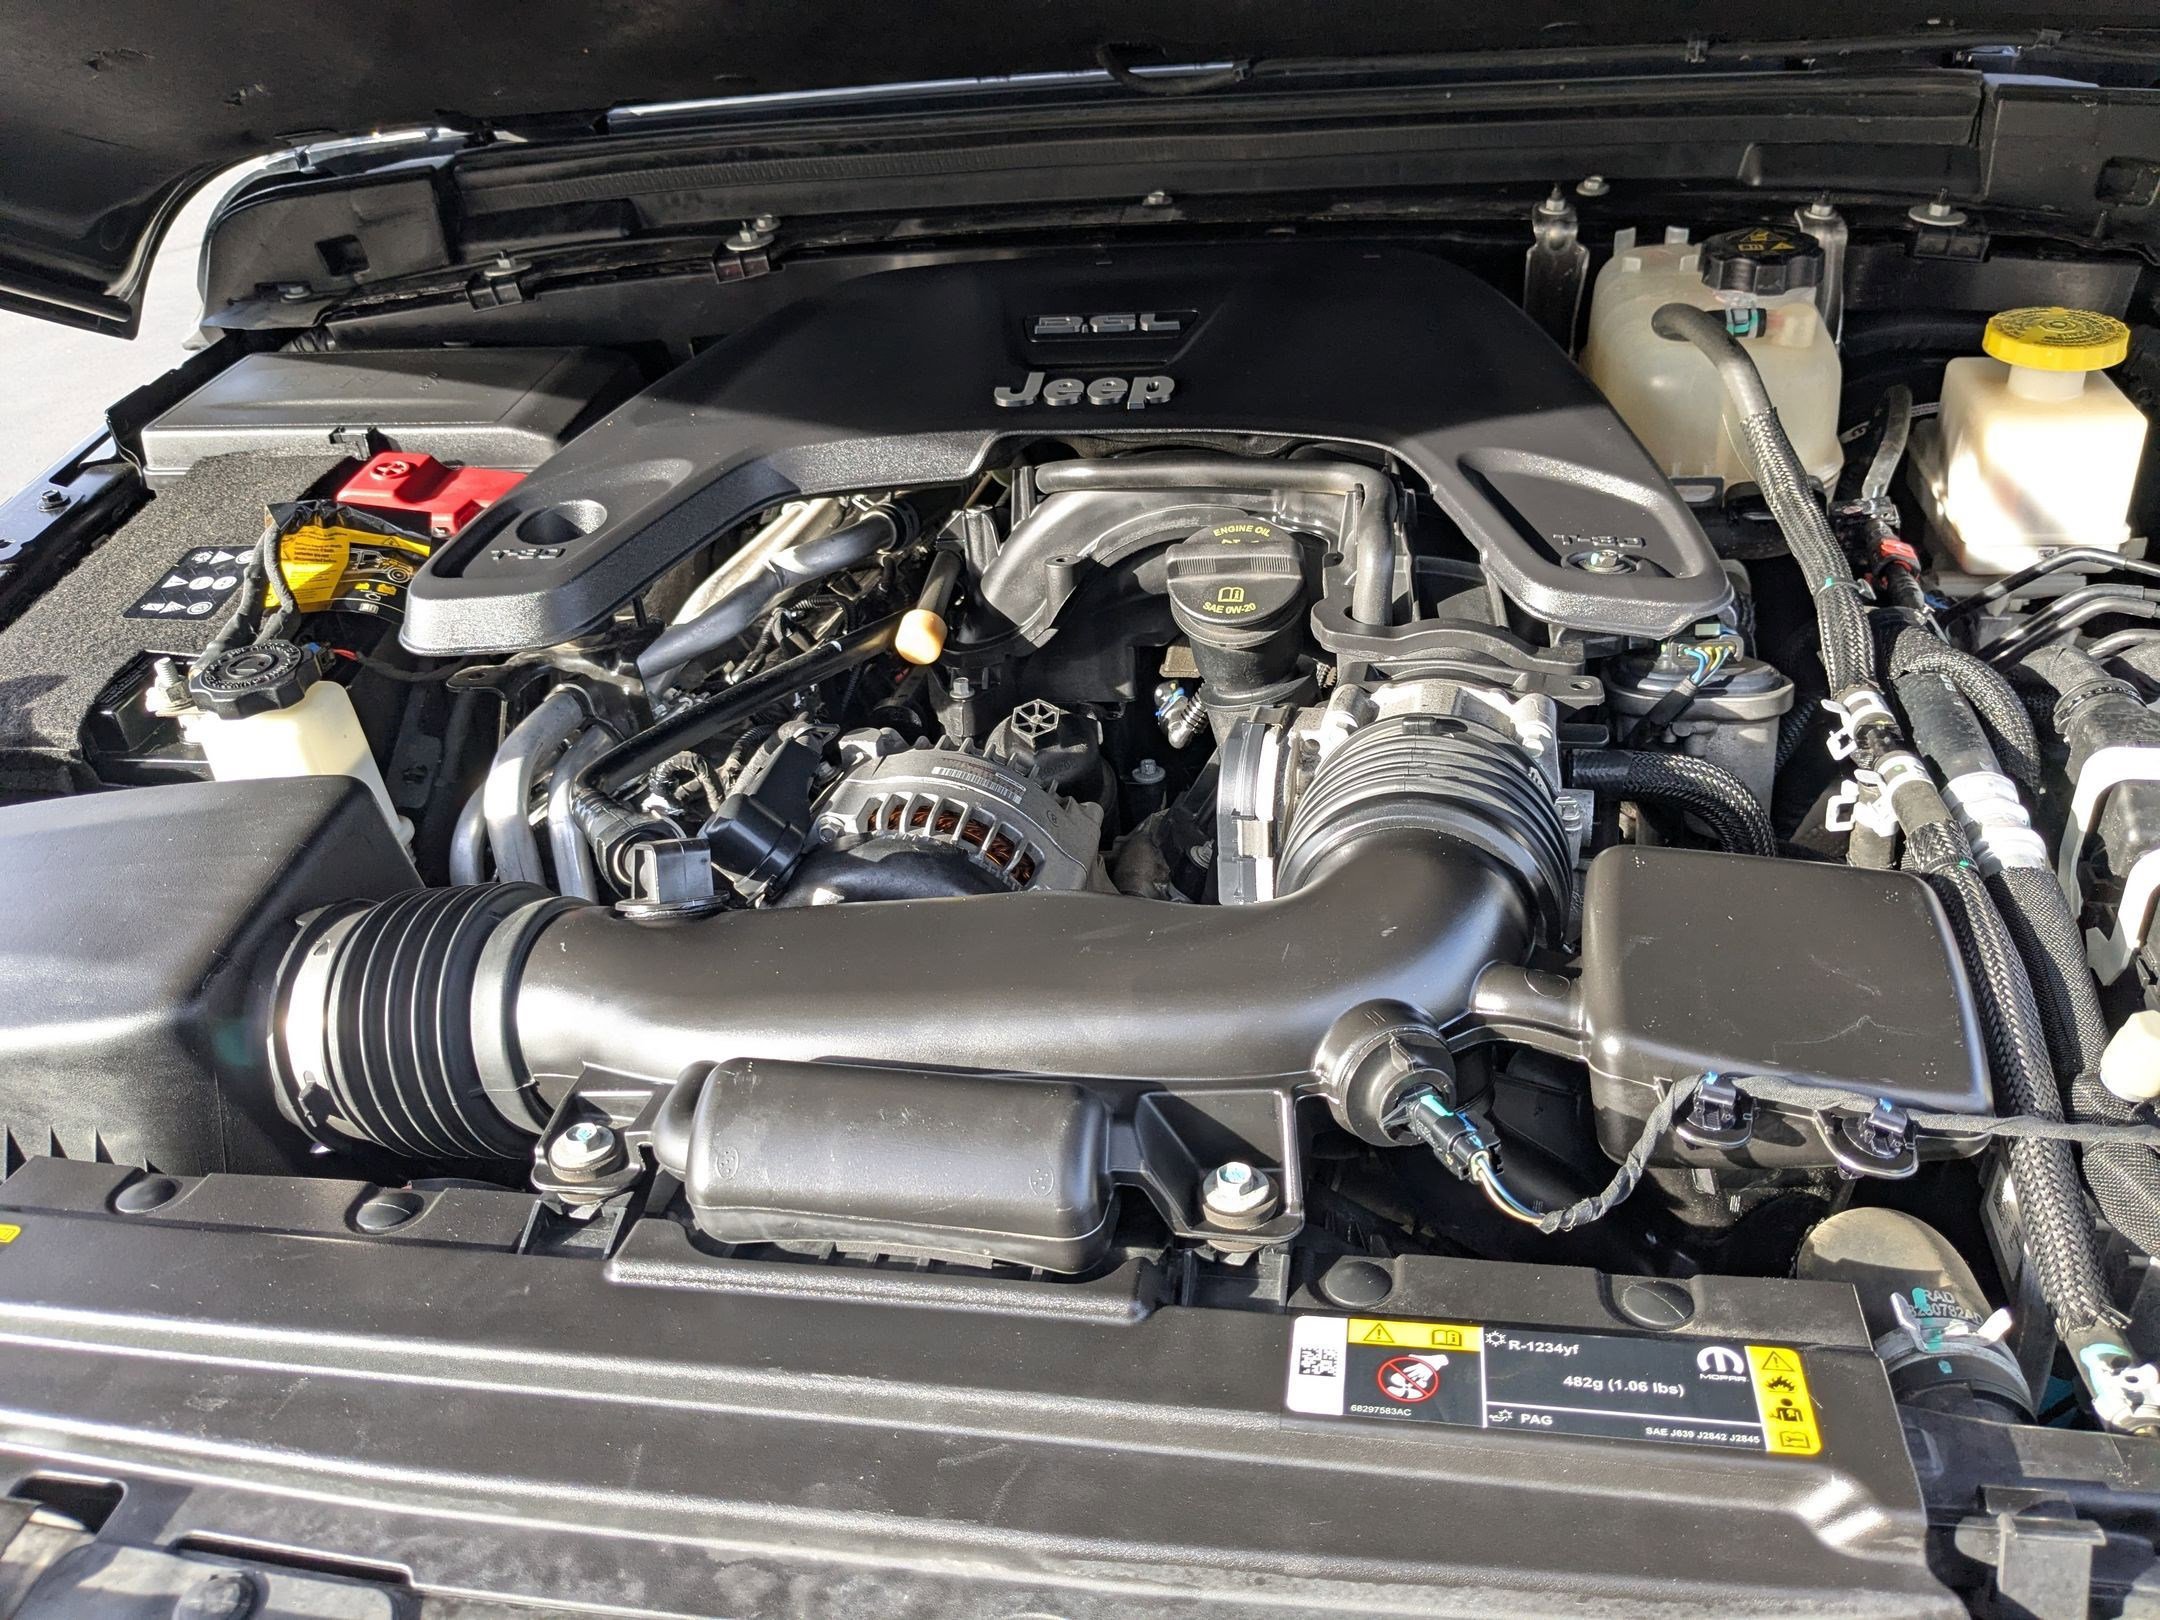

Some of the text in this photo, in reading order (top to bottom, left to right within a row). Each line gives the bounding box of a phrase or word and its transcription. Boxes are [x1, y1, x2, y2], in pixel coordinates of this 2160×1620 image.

[993, 371, 1176, 410] Jeep
[1213, 524, 1271, 537] ENGINE OIL
[1202, 602, 1256, 614] SAE 0W-20
[1508, 1339, 1580, 1357] R-1234yf
[1563, 1375, 1685, 1398] 482g (1.06 lbs)
[1350, 1404, 1412, 1417] 68297583AC
[1520, 1413, 1553, 1425] PAG
[1645, 1426, 1760, 1444] SAE J639 J2842 J2845
